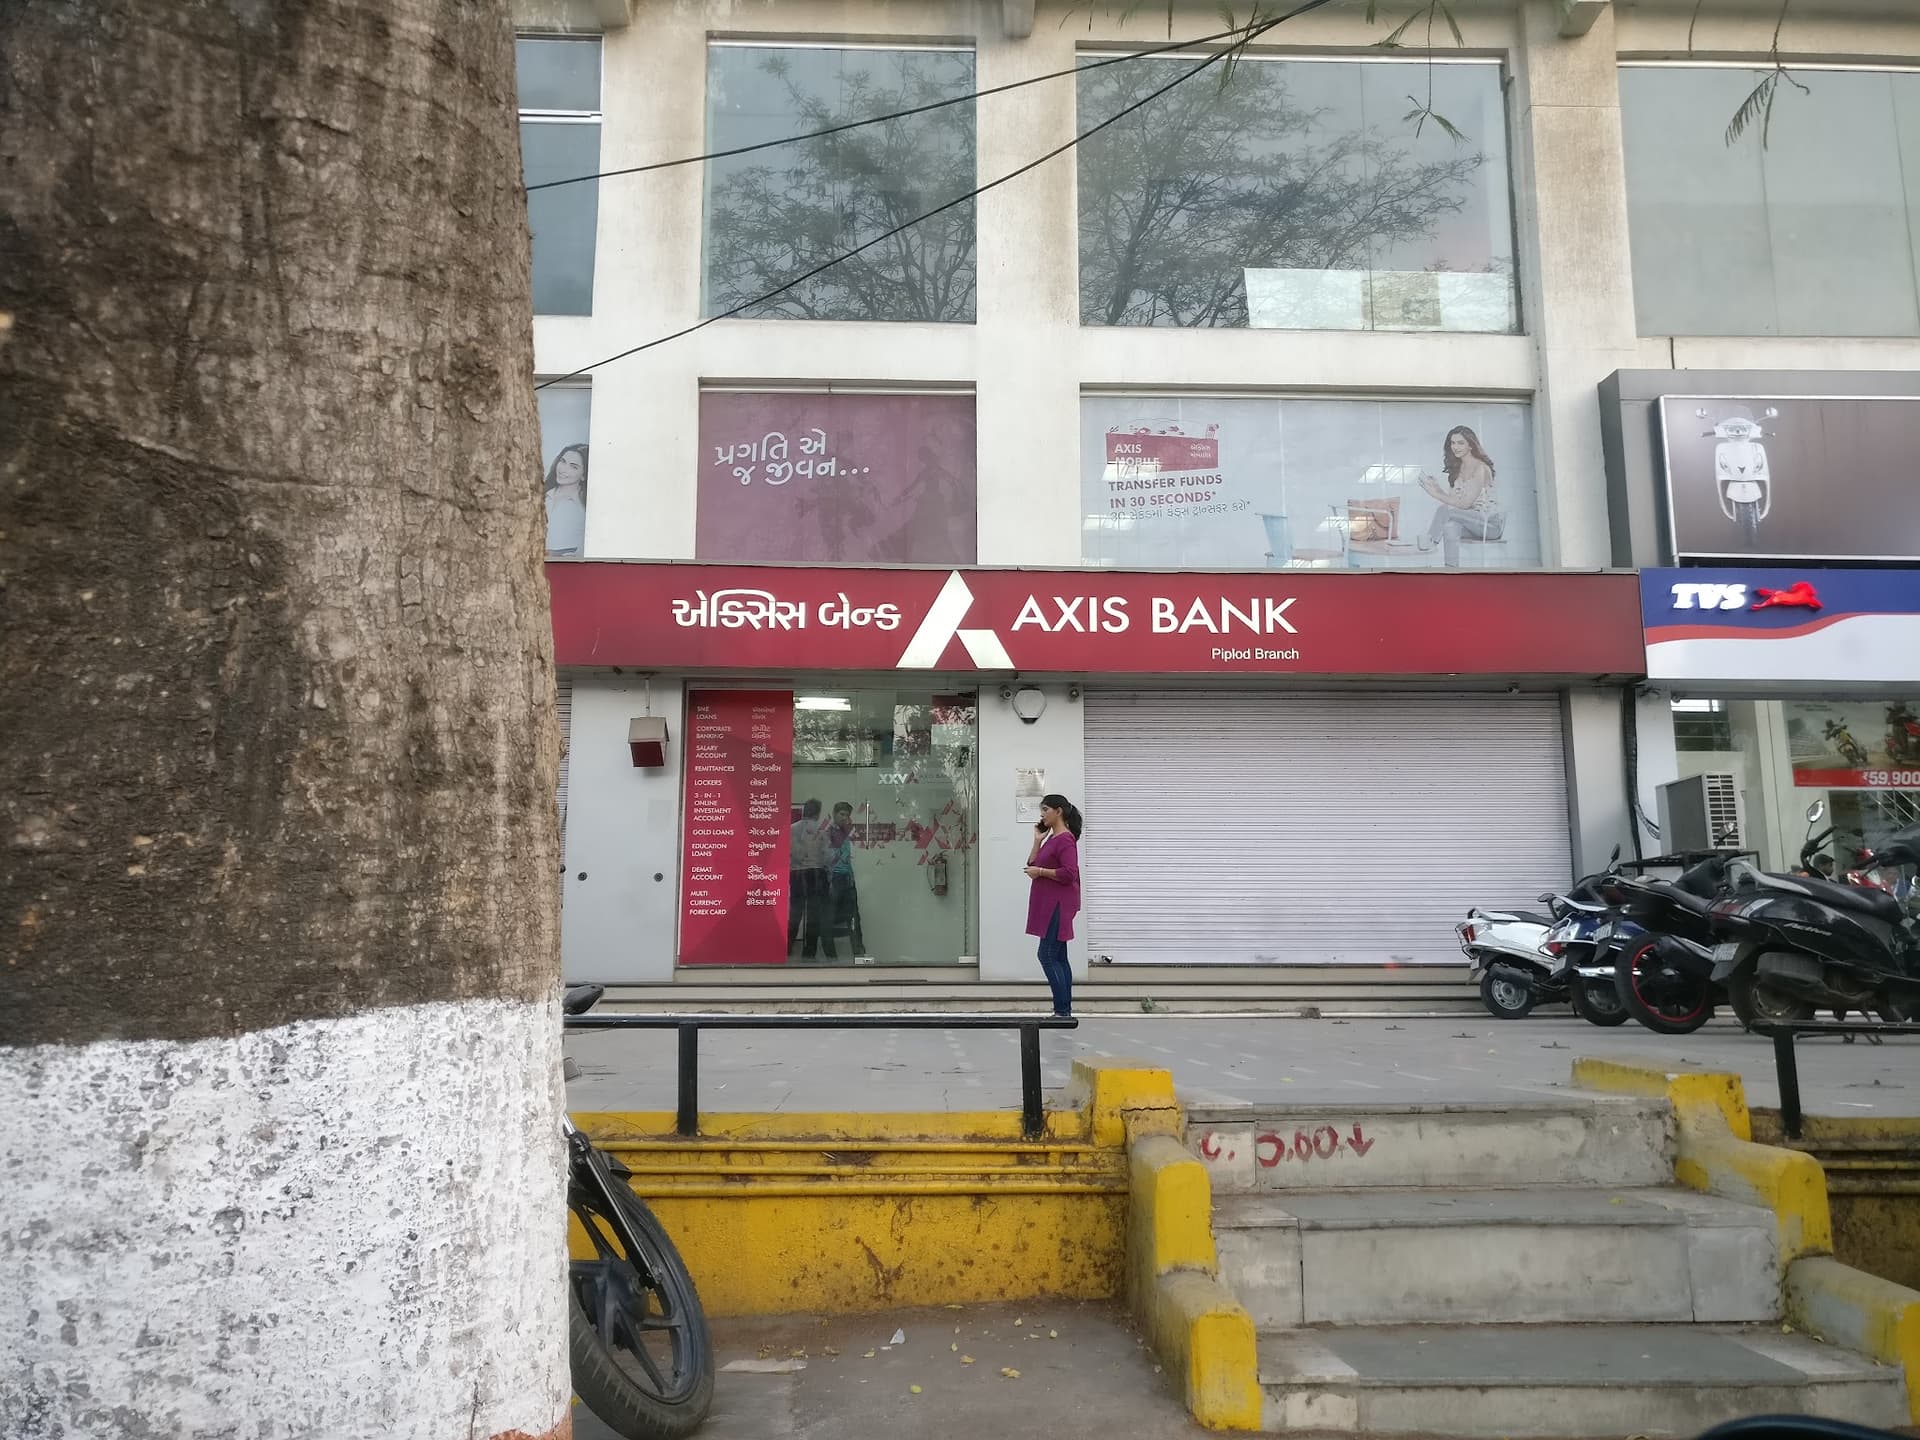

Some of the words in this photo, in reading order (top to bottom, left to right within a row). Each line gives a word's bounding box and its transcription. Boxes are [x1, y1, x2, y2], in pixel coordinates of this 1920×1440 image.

[714, 432, 789, 466] પ્રગતિ
[799, 428, 827, 455] એ
[1114, 444, 1142, 453] AXIS
[733, 466, 756, 486] જ
[765, 456, 870, 486] જીવન...
[1108, 478, 1176, 491] TRANSFER
[1180, 474, 1222, 486] FUNDS
[1110, 498, 1126, 508] IN
[1130, 496, 1145, 507] 30
[672, 588, 807, 632] એક્સિસ
[818, 593, 901, 631] બેન્ક
[1671, 583, 1747, 610] TVS
[1011, 594, 1130, 633] AXIS
[1151, 598, 1298, 634] BANK
[1212, 648, 1250, 662] Piplod
[1255, 648, 1299, 660] Branch
